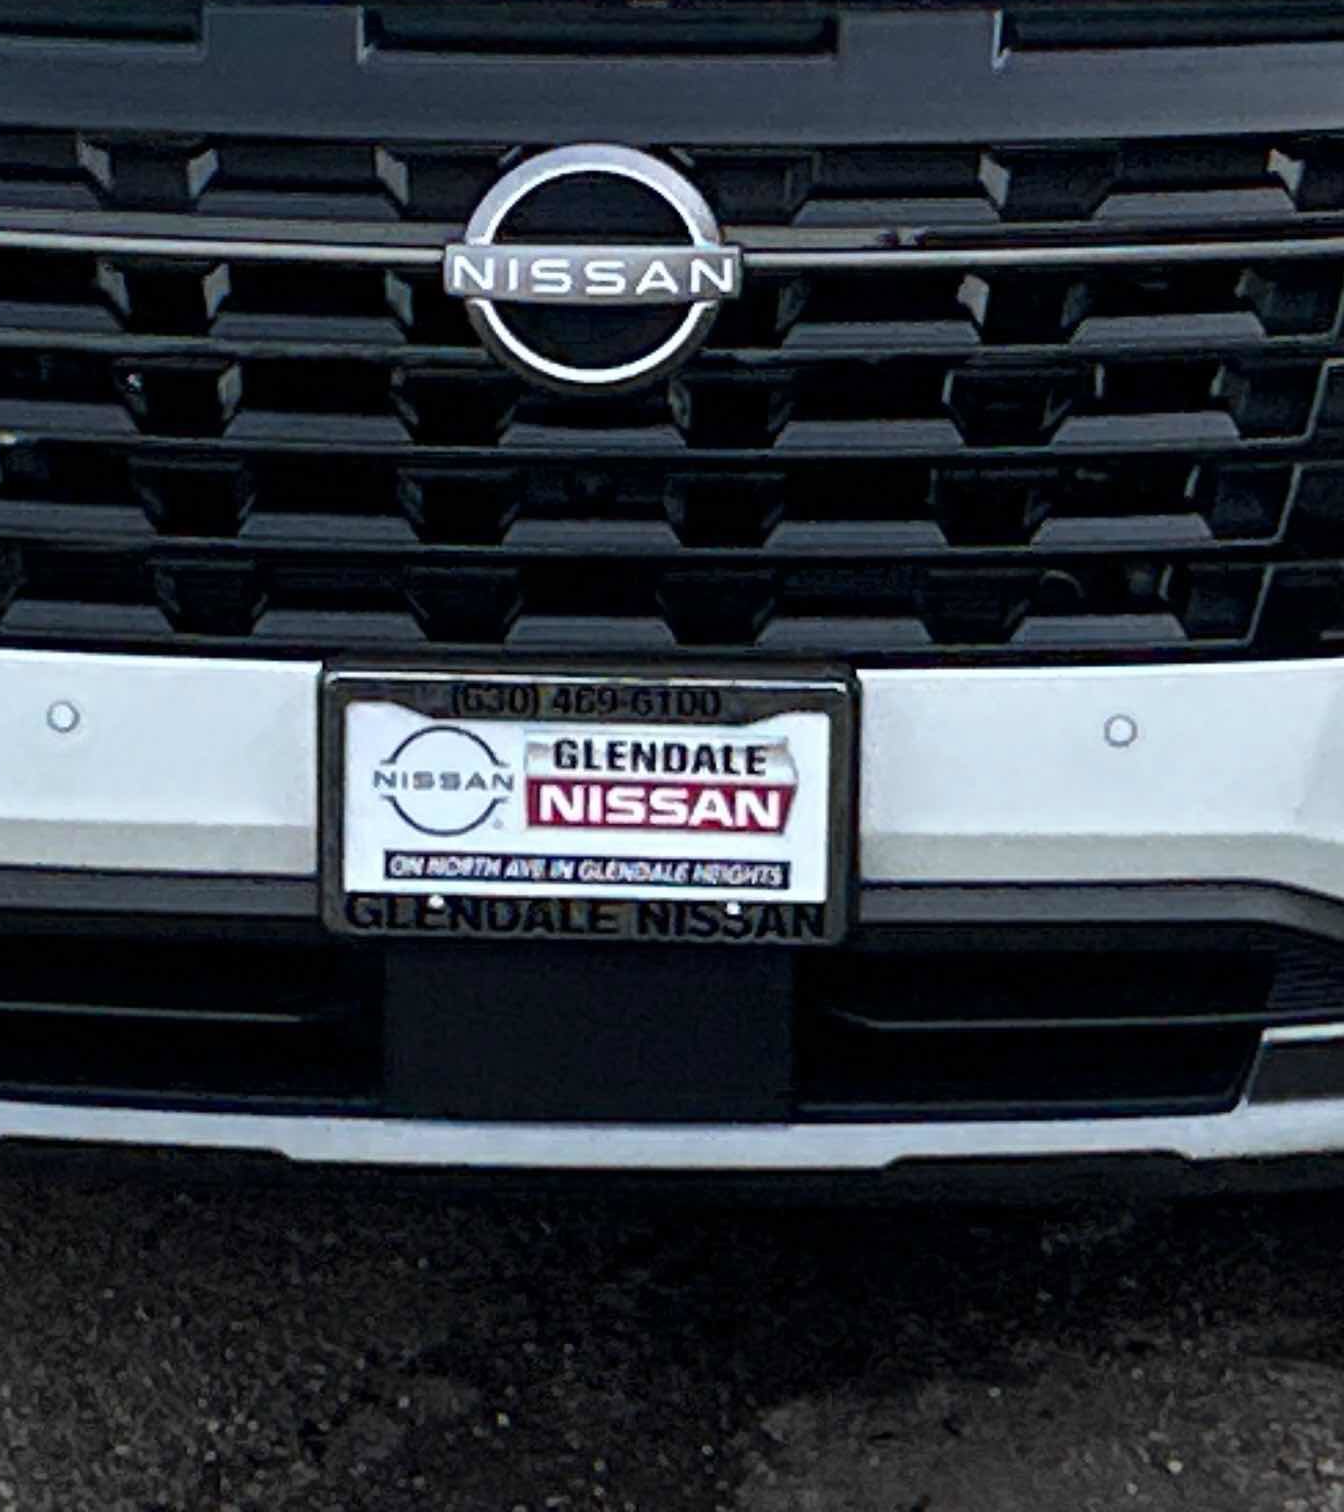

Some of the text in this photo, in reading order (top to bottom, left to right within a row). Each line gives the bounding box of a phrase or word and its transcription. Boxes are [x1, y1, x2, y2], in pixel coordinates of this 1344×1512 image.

[452, 255, 735, 295] NISSAN
[453, 683, 540, 718] (630)
[554, 739, 768, 777] GLENDALE
[372, 769, 515, 791] NISSAN
[538, 783, 782, 829] NISSAN
[389, 854, 424, 876] ON
[426, 855, 501, 878] NORTH
[550, 859, 575, 880] IN
[578, 859, 690, 884] GLENDALE
[692, 863, 784, 887] HEIGHTS
[346, 895, 825, 937] GLENDALE NISSAN
